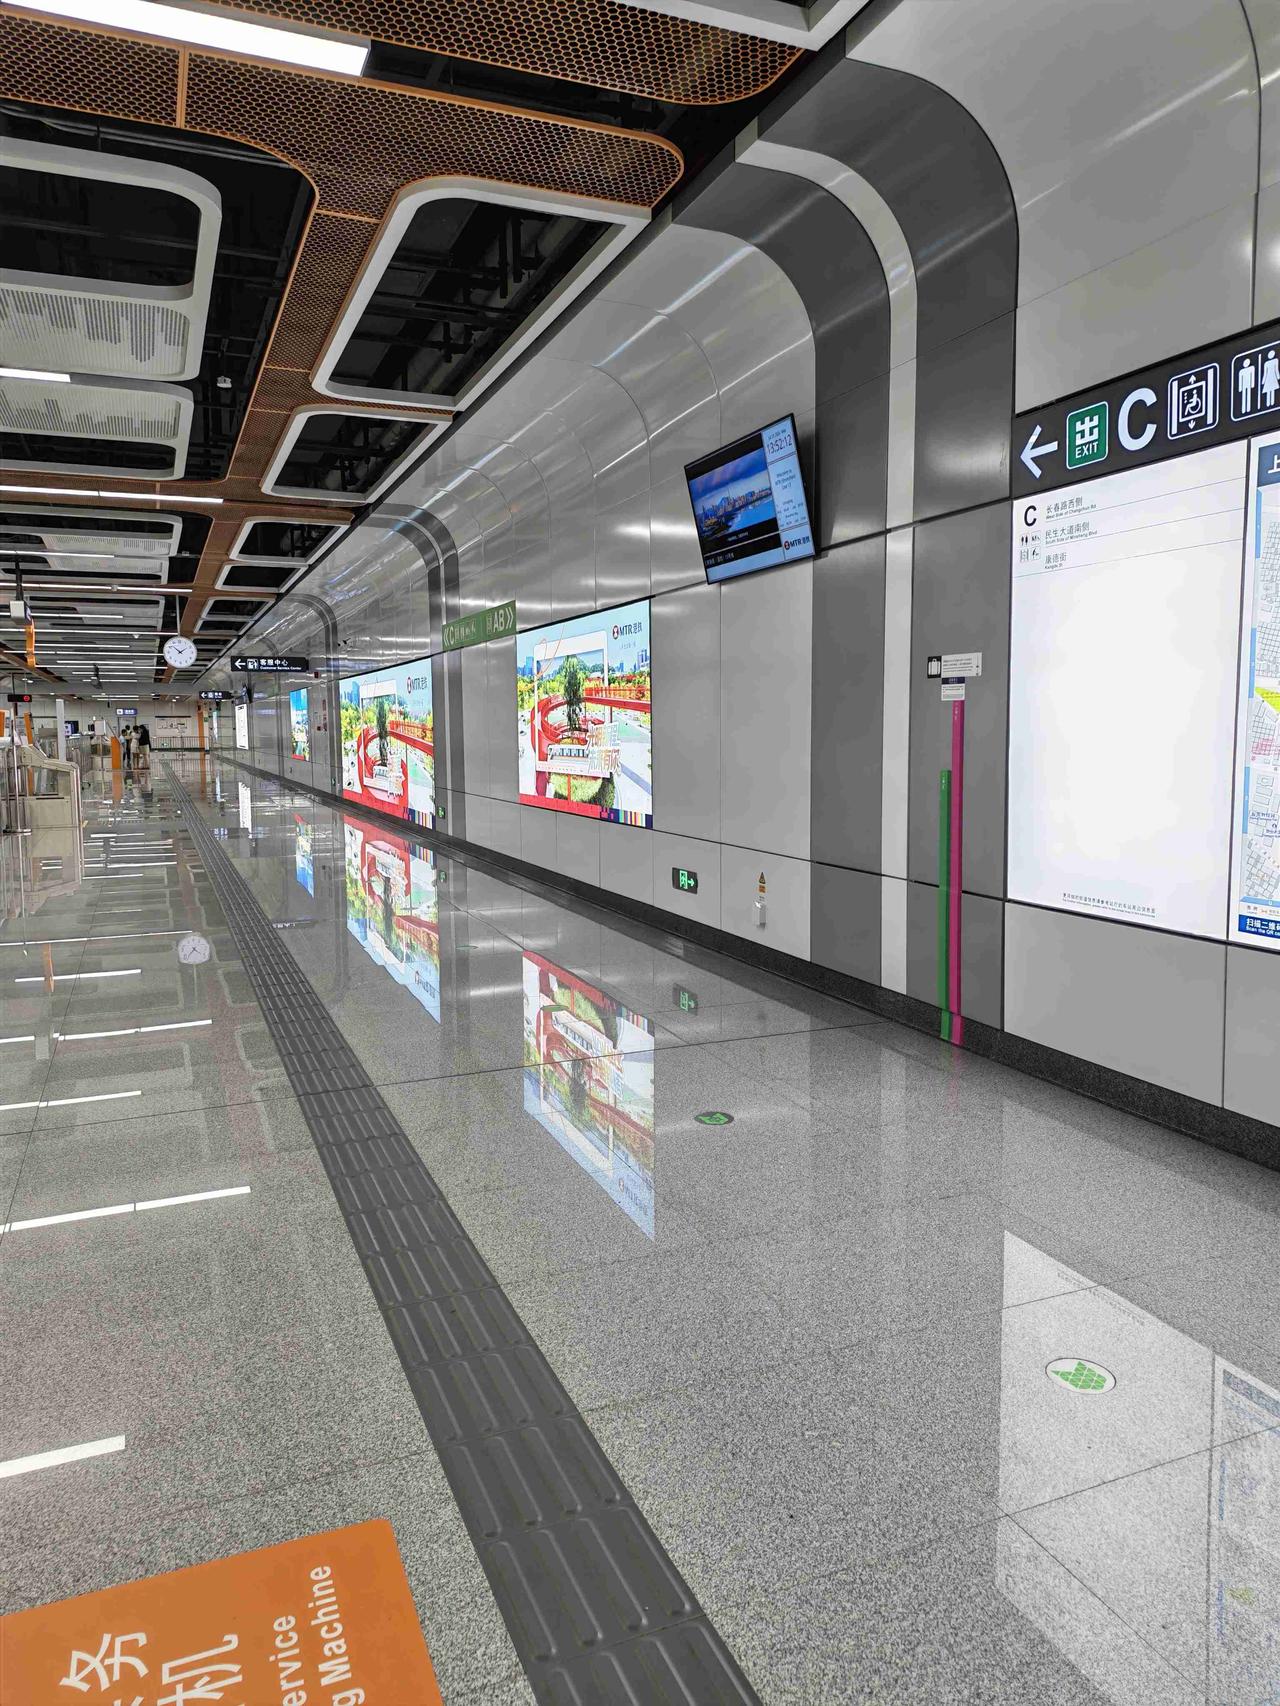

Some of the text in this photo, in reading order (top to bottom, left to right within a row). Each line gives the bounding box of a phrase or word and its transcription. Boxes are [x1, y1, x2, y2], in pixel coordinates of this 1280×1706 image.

[1117, 387, 1157, 450] C
[1075, 441, 1099, 459] EXIT
[1024, 505, 1037, 527] C
[493, 612, 505, 632] AB
[619, 624, 633, 636] MTR
[260, 658, 288, 666] 客服中心
[308, 1565, 352, 1688] Machine
[59, 1632, 149, 1706] 务
[269, 1615, 307, 1706] ervice
